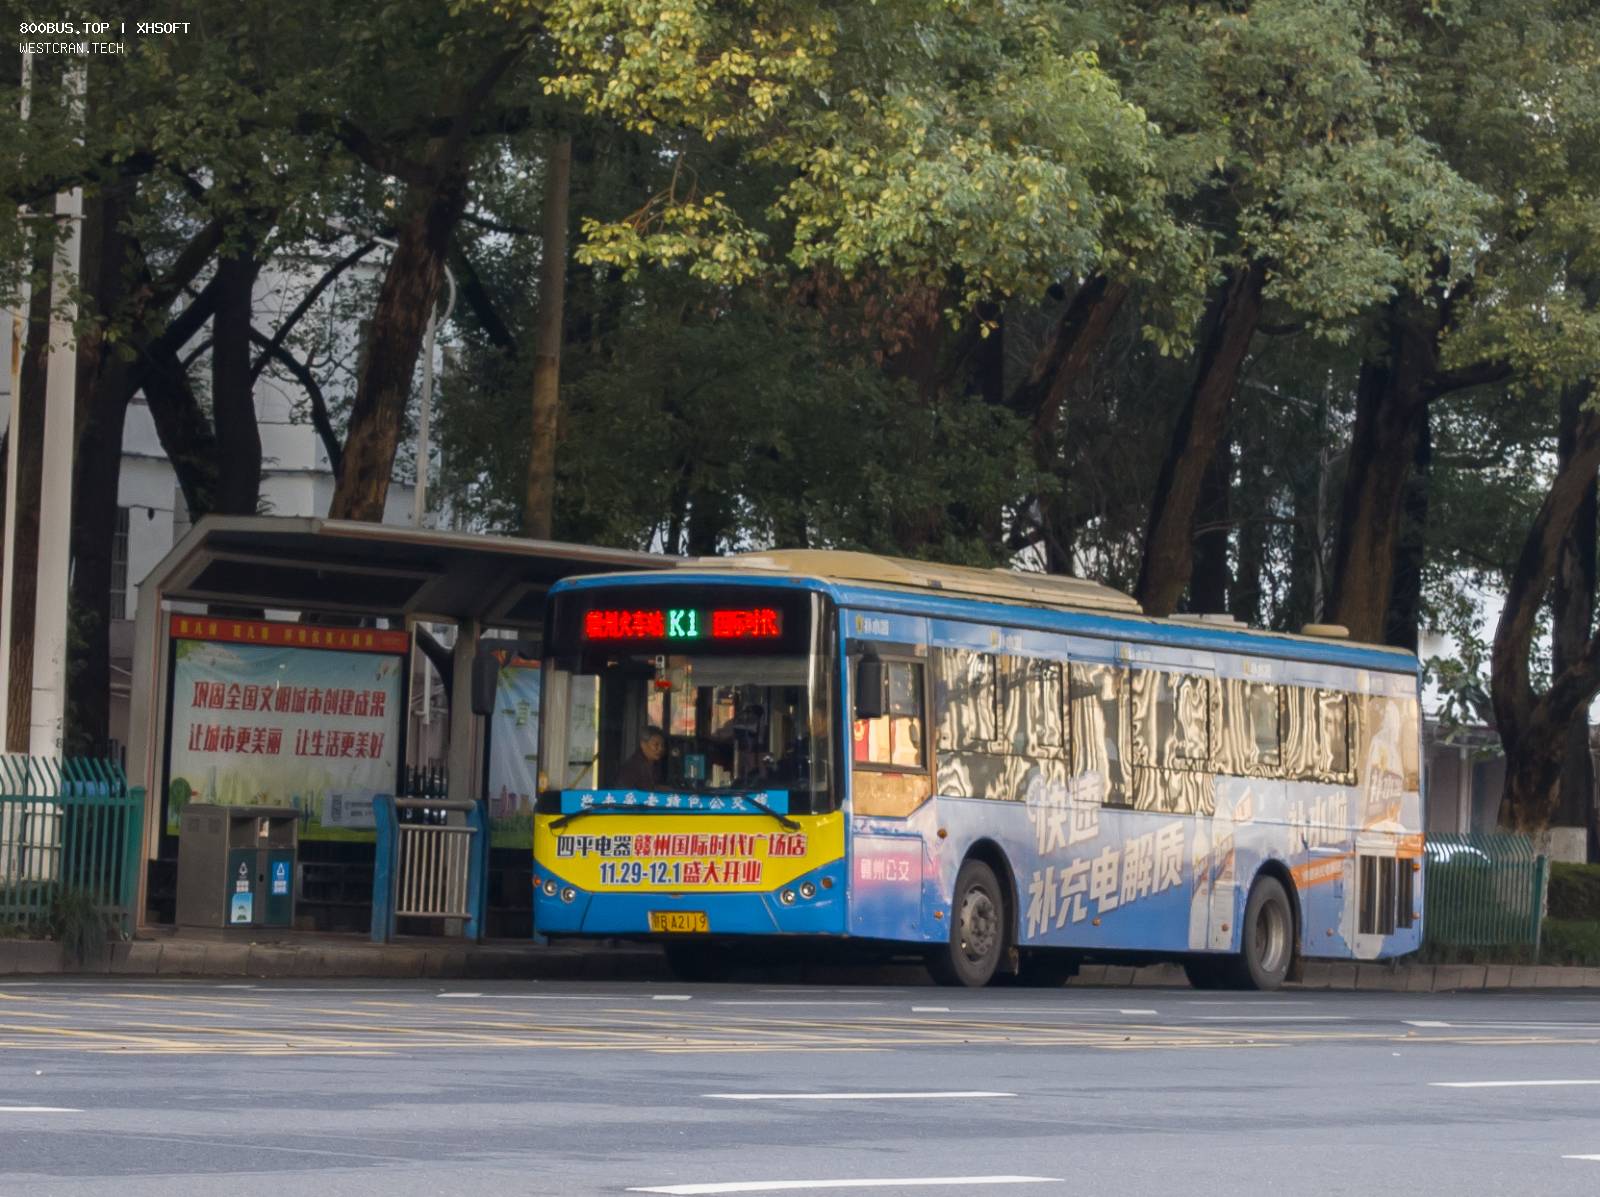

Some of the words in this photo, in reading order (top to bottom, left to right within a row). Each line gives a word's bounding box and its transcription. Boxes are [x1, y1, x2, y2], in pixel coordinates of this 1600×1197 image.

[668, 609, 699, 638] K1
[191, 681, 387, 717] 巩固全国文明城市创建成果
[188, 723, 283, 755] 让城市更美丽
[295, 728, 385, 759] 让生活更美好
[1026, 820, 1186, 939] 补充电解质
